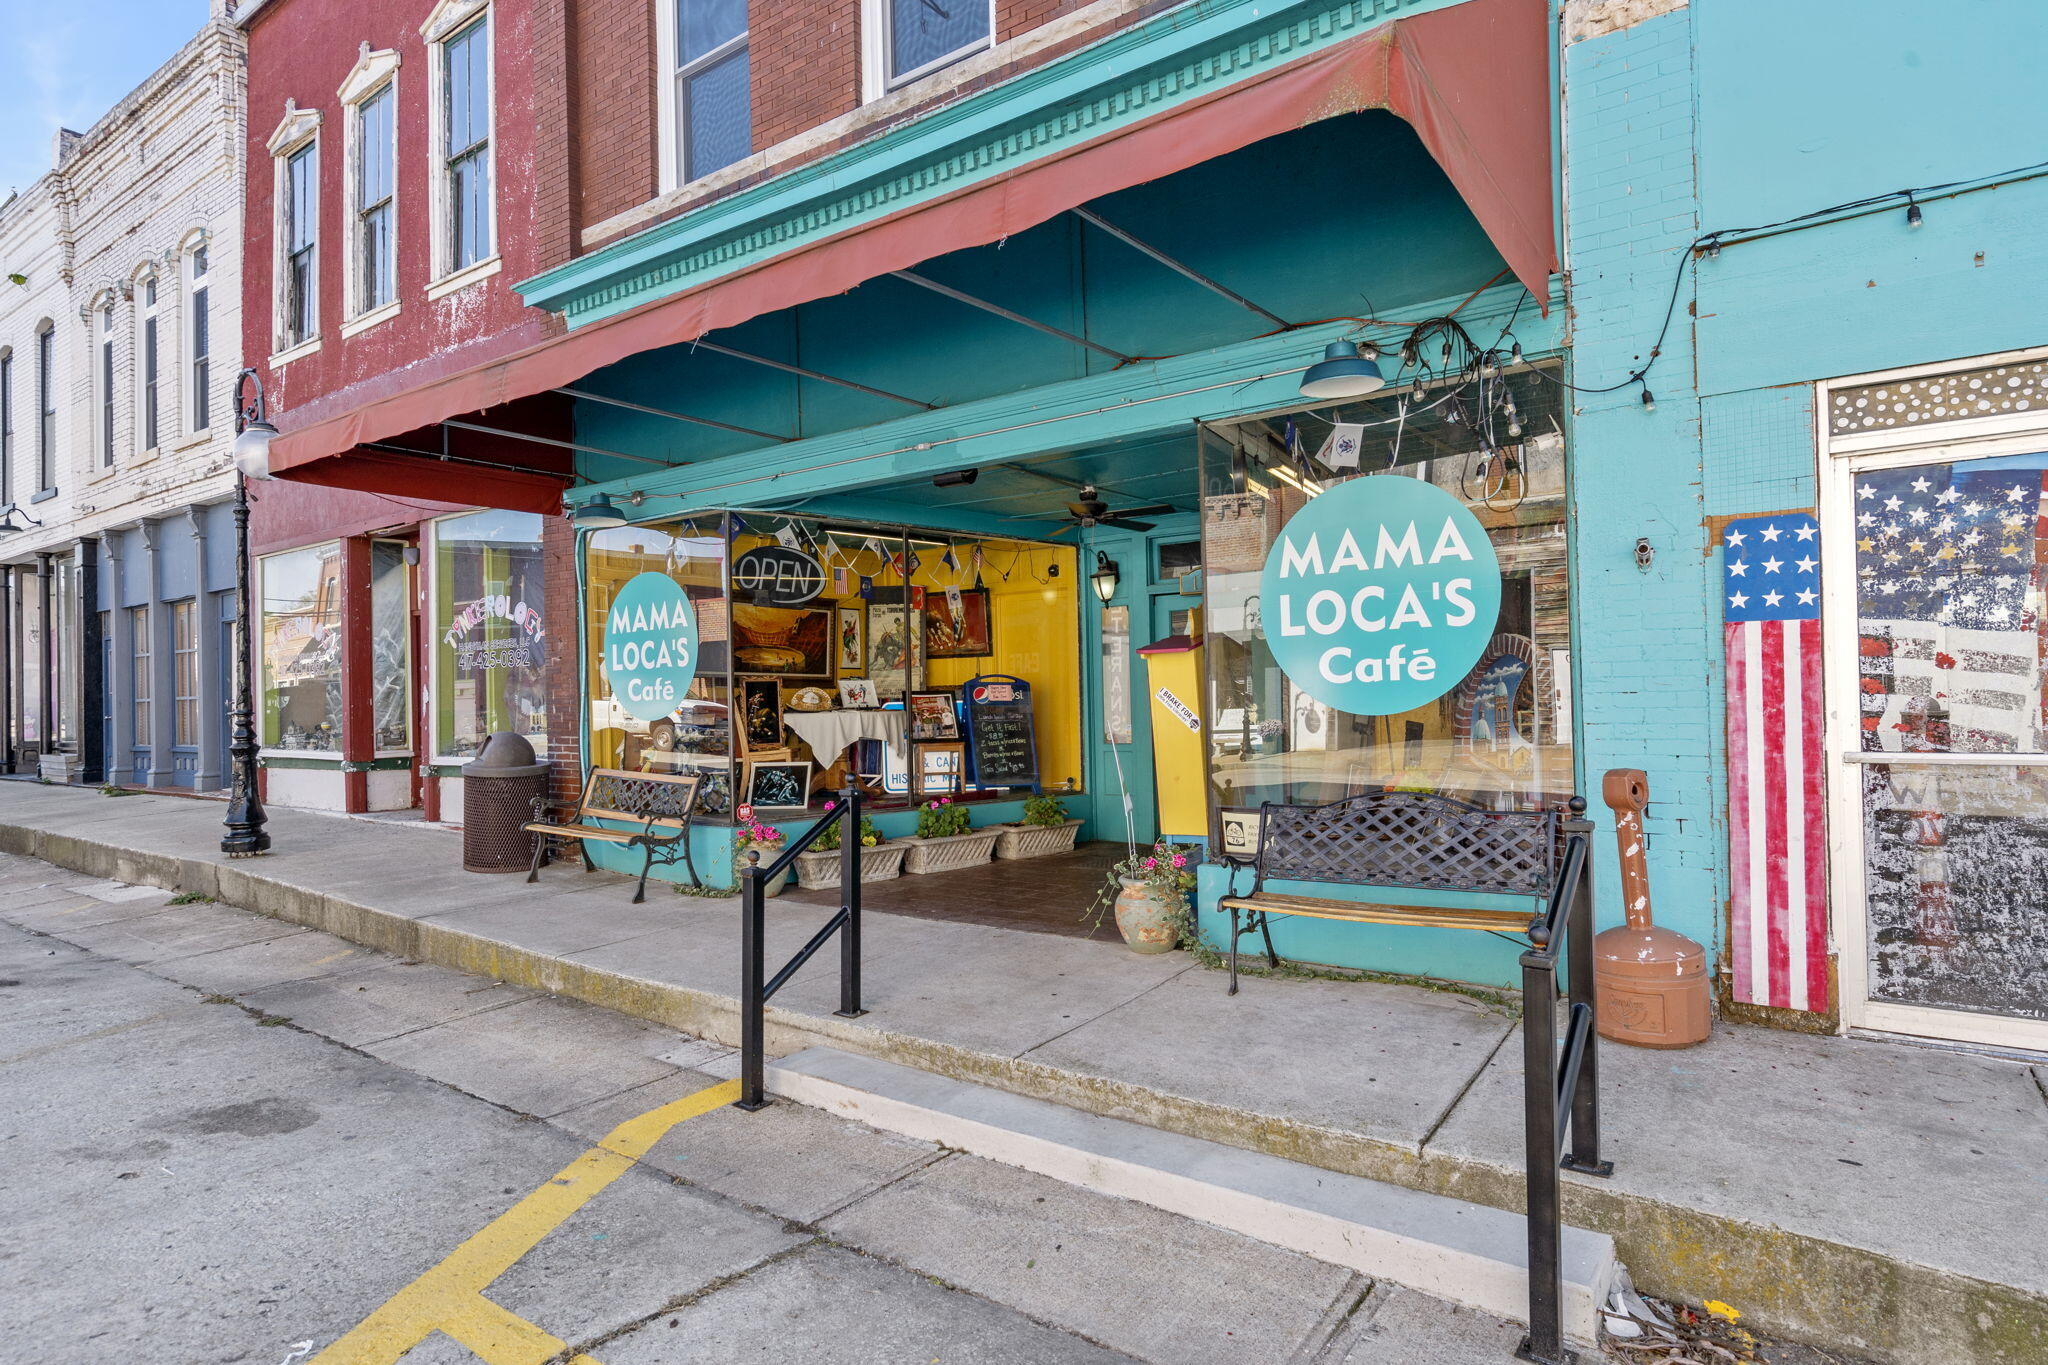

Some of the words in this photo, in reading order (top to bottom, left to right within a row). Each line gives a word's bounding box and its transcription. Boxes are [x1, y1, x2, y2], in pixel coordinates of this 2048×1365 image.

[1279, 515, 1474, 579] MAMA
[739, 555, 811, 594] OPEN
[612, 599, 688, 634] MAMA
[1279, 577, 1477, 637] LOCA'S
[612, 637, 690, 672] LOCA'S
[1318, 643, 1436, 684] Café
[627, 677, 675, 703] Café
[1162, 690, 1182, 709] BRAKE
[1180, 707, 1193, 719] FOR
